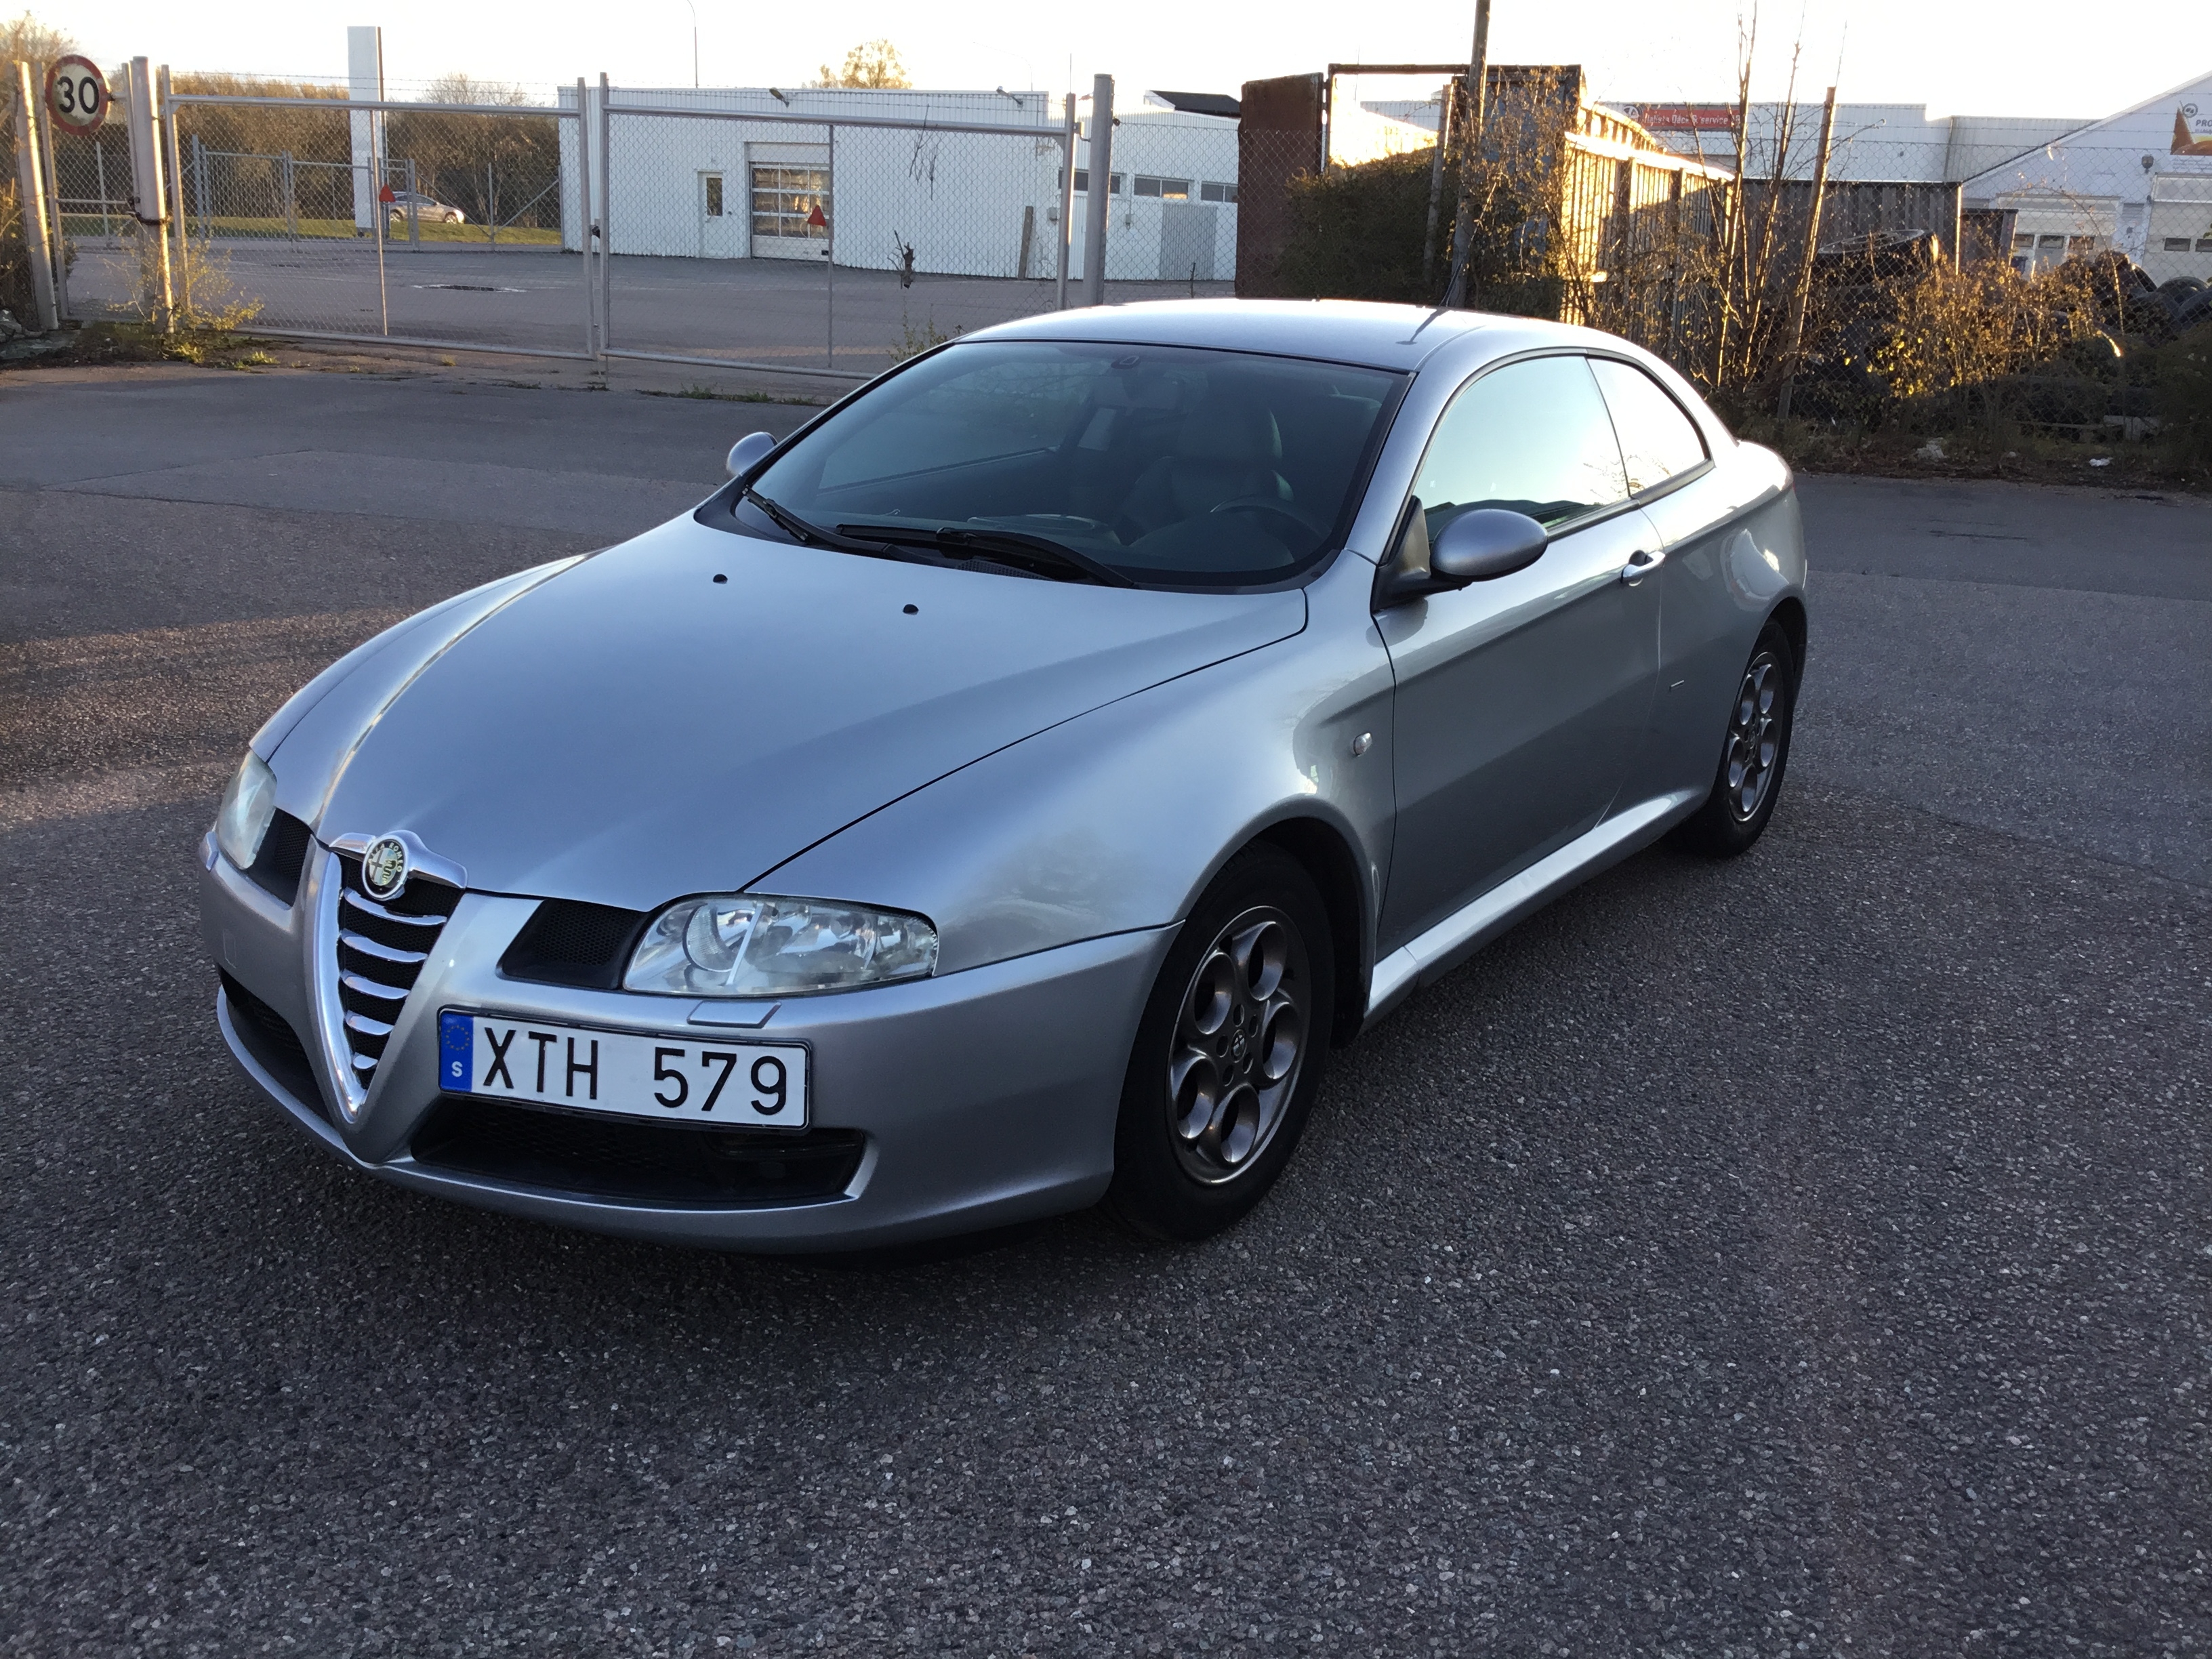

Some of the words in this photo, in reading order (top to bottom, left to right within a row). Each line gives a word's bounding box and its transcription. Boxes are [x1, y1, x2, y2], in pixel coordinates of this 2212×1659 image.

[57, 76, 100, 115] 30
[1700, 115, 1728, 125] service
[389, 842, 403, 872] ROMEO
[451, 1061, 463, 1077] S
[483, 1027, 598, 1100] XTH
[653, 1047, 787, 1116] 579
